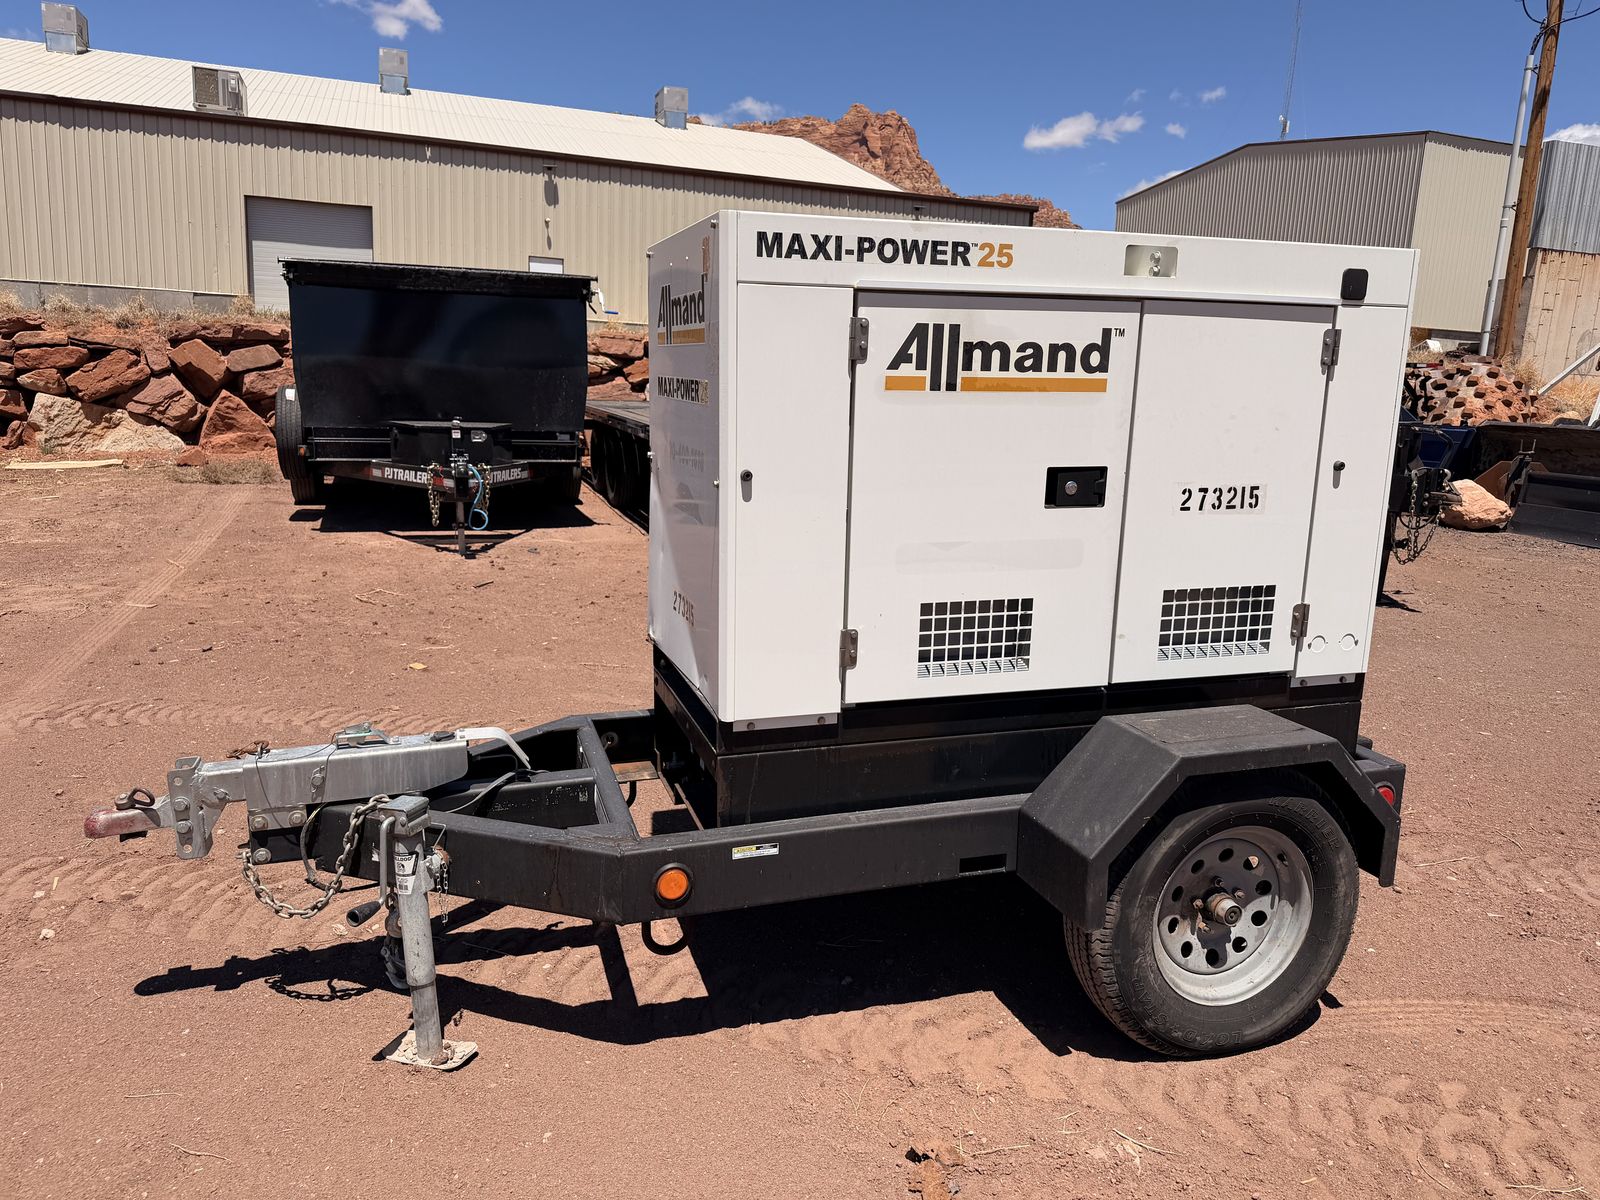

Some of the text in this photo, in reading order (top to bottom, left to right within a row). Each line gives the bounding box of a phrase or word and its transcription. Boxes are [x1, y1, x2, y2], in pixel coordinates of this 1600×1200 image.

[977, 242, 1014, 268] 25
[657, 273, 705, 344] Allmand
[886, 323, 1113, 391] Allmand
[657, 376, 700, 402] MAXI-POWER
[394, 468, 431, 484] TRAILER
[1180, 485, 1260, 512] 273215
[672, 591, 695, 627] 273215
